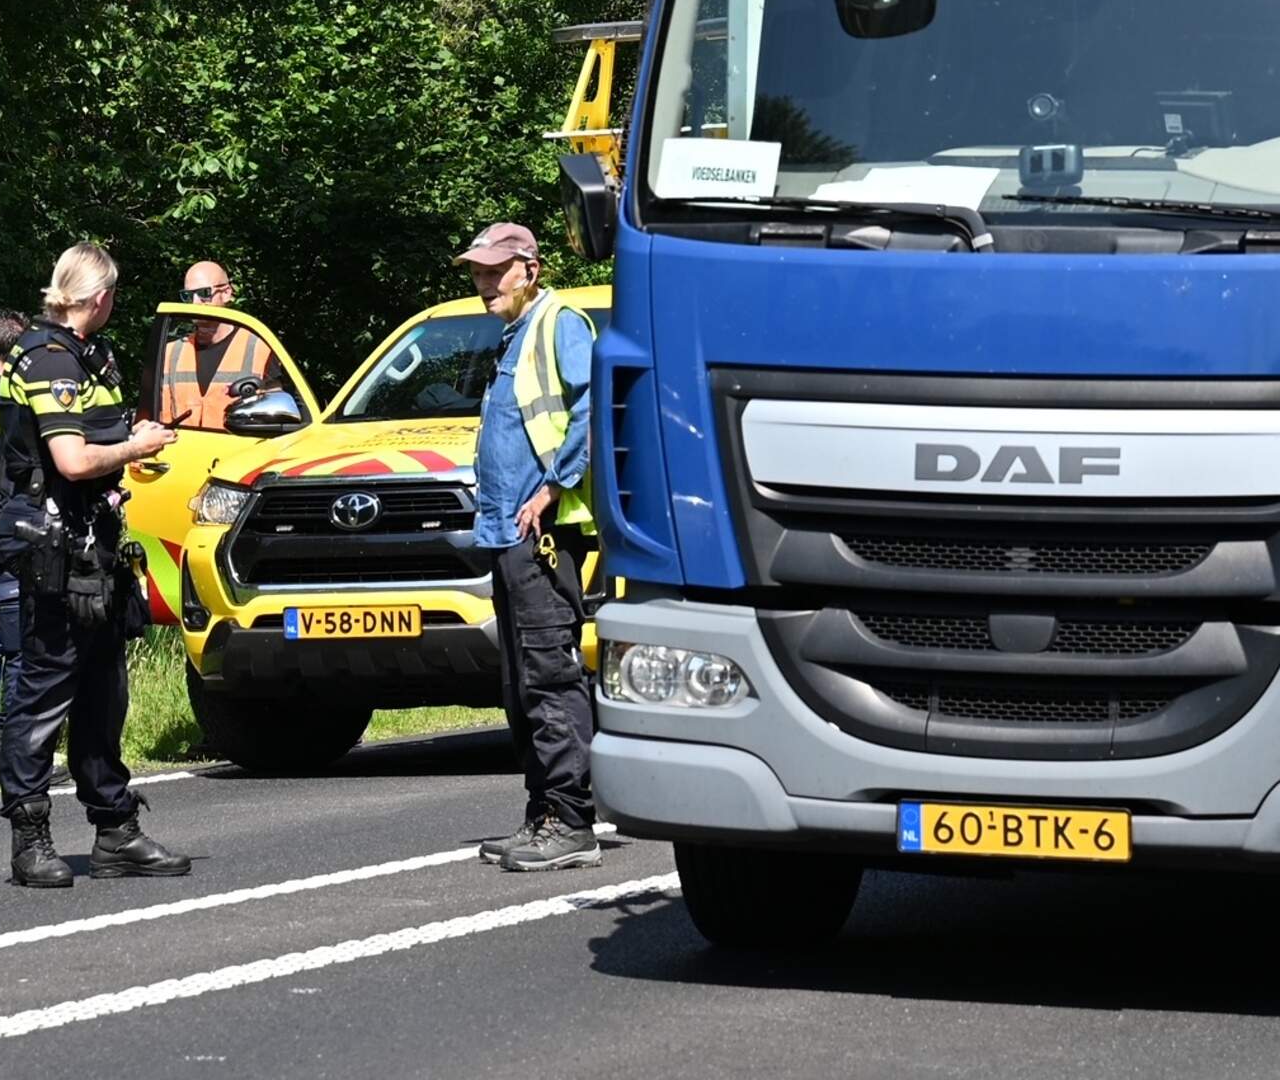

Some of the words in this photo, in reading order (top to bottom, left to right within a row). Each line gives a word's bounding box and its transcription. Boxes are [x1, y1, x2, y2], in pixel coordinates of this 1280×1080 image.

[692, 167, 757, 184] VOEDSELBANKEN
[914, 442, 1122, 485] DAF
[300, 610, 413, 634] V-58-DNN
[903, 830, 919, 842] NL
[932, 810, 1116, 852] 60-BTK-6
